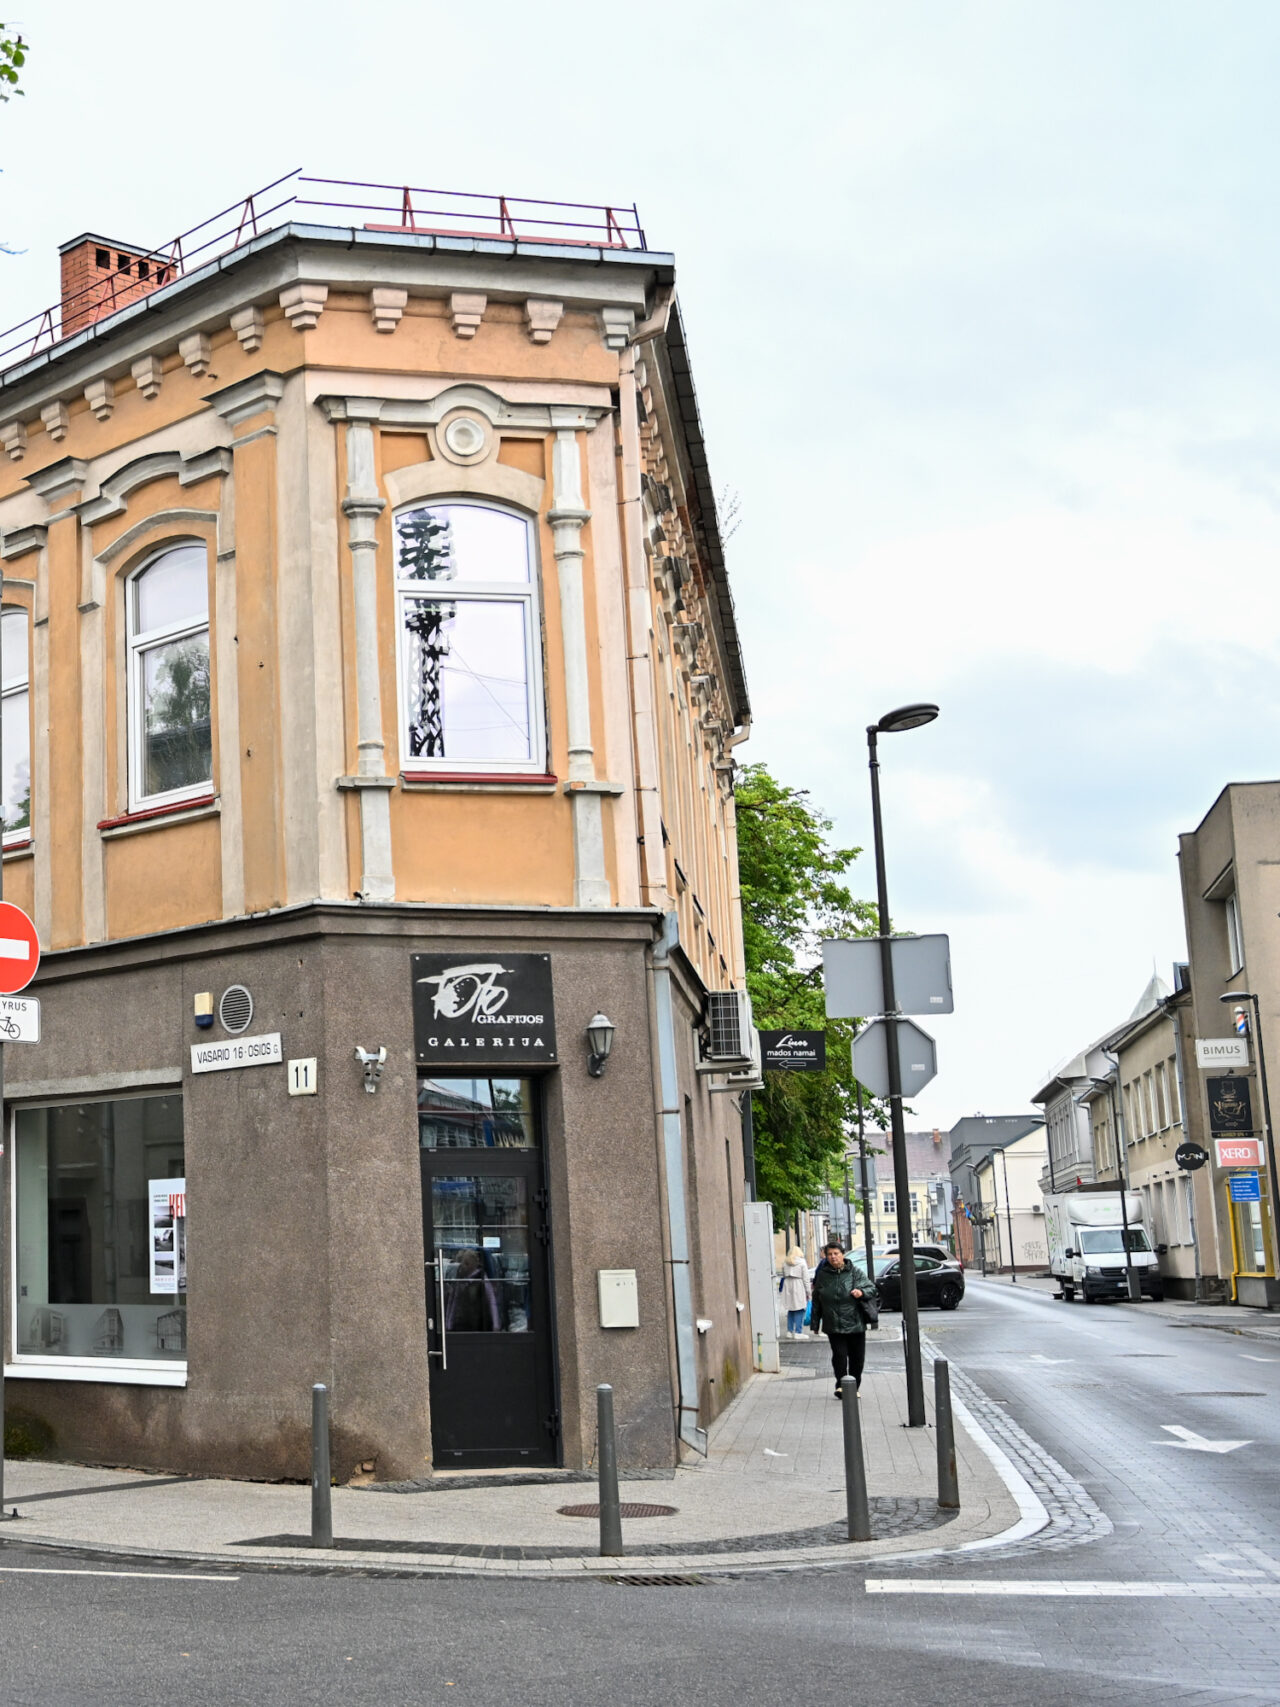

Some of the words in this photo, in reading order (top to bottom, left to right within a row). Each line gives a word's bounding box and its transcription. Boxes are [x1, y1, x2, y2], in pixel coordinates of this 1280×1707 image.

[477, 1014, 544, 1024] GRAFIJOS
[427, 1037, 544, 1047] GALERIJA
[1203, 1045, 1241, 1055] BIMUS
[197, 1048, 230, 1064] VASARIO
[295, 1065, 308, 1088] 11
